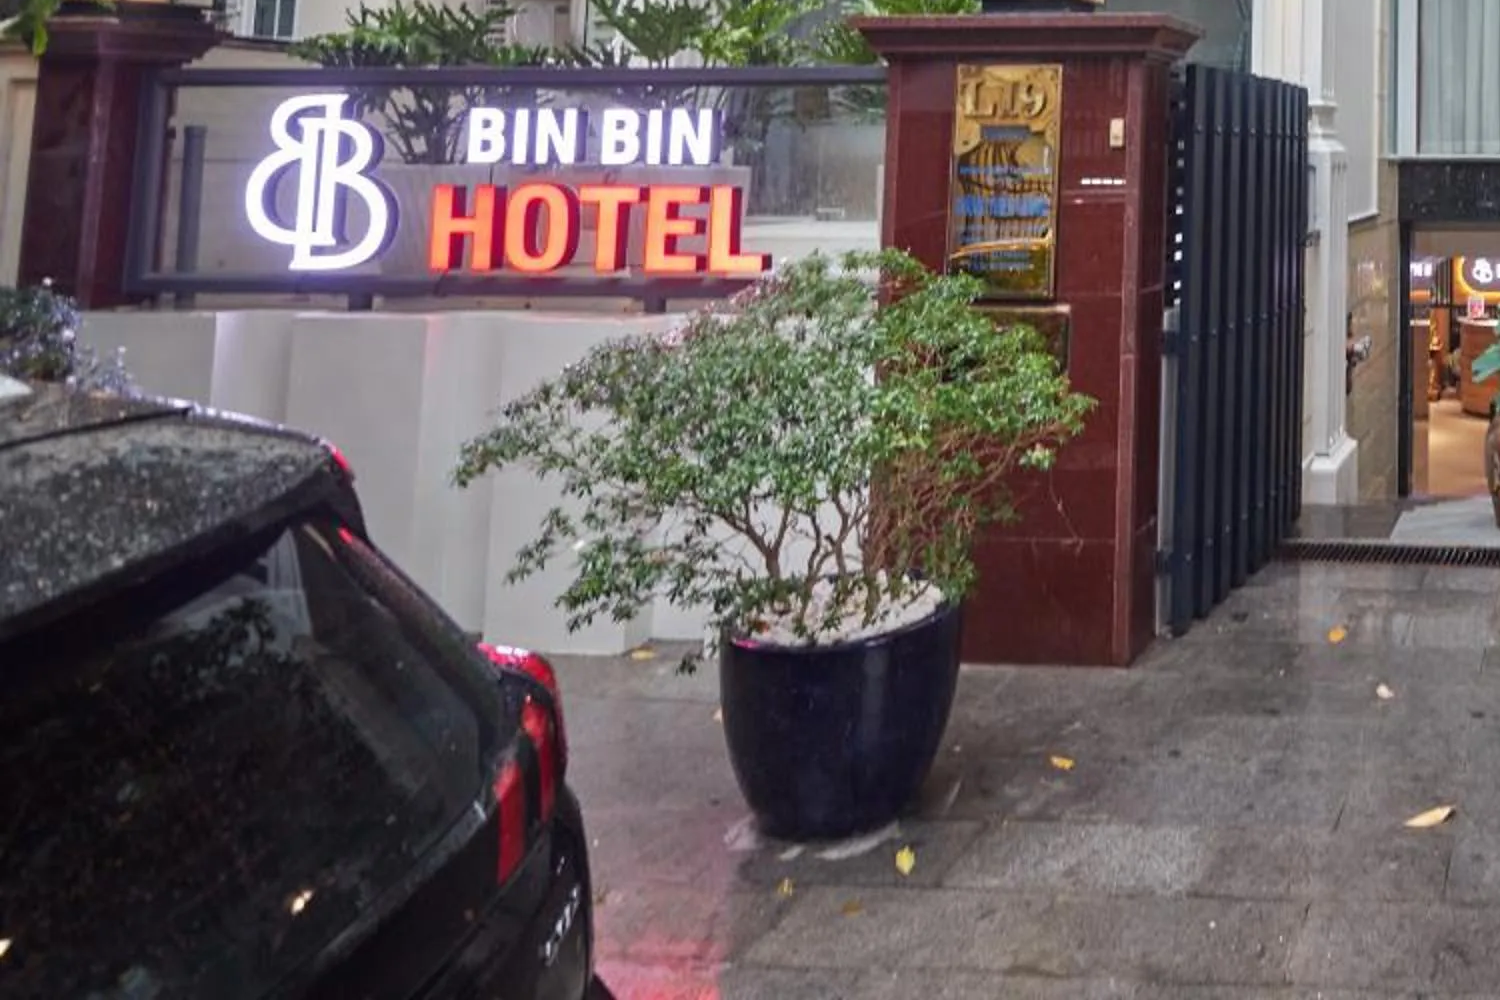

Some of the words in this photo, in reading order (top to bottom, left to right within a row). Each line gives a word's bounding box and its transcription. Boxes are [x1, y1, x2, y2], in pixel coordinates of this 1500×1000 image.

[466, 107, 578, 166] BIN
[600, 107, 714, 166] BIN
[428, 182, 771, 275] HOTEL
